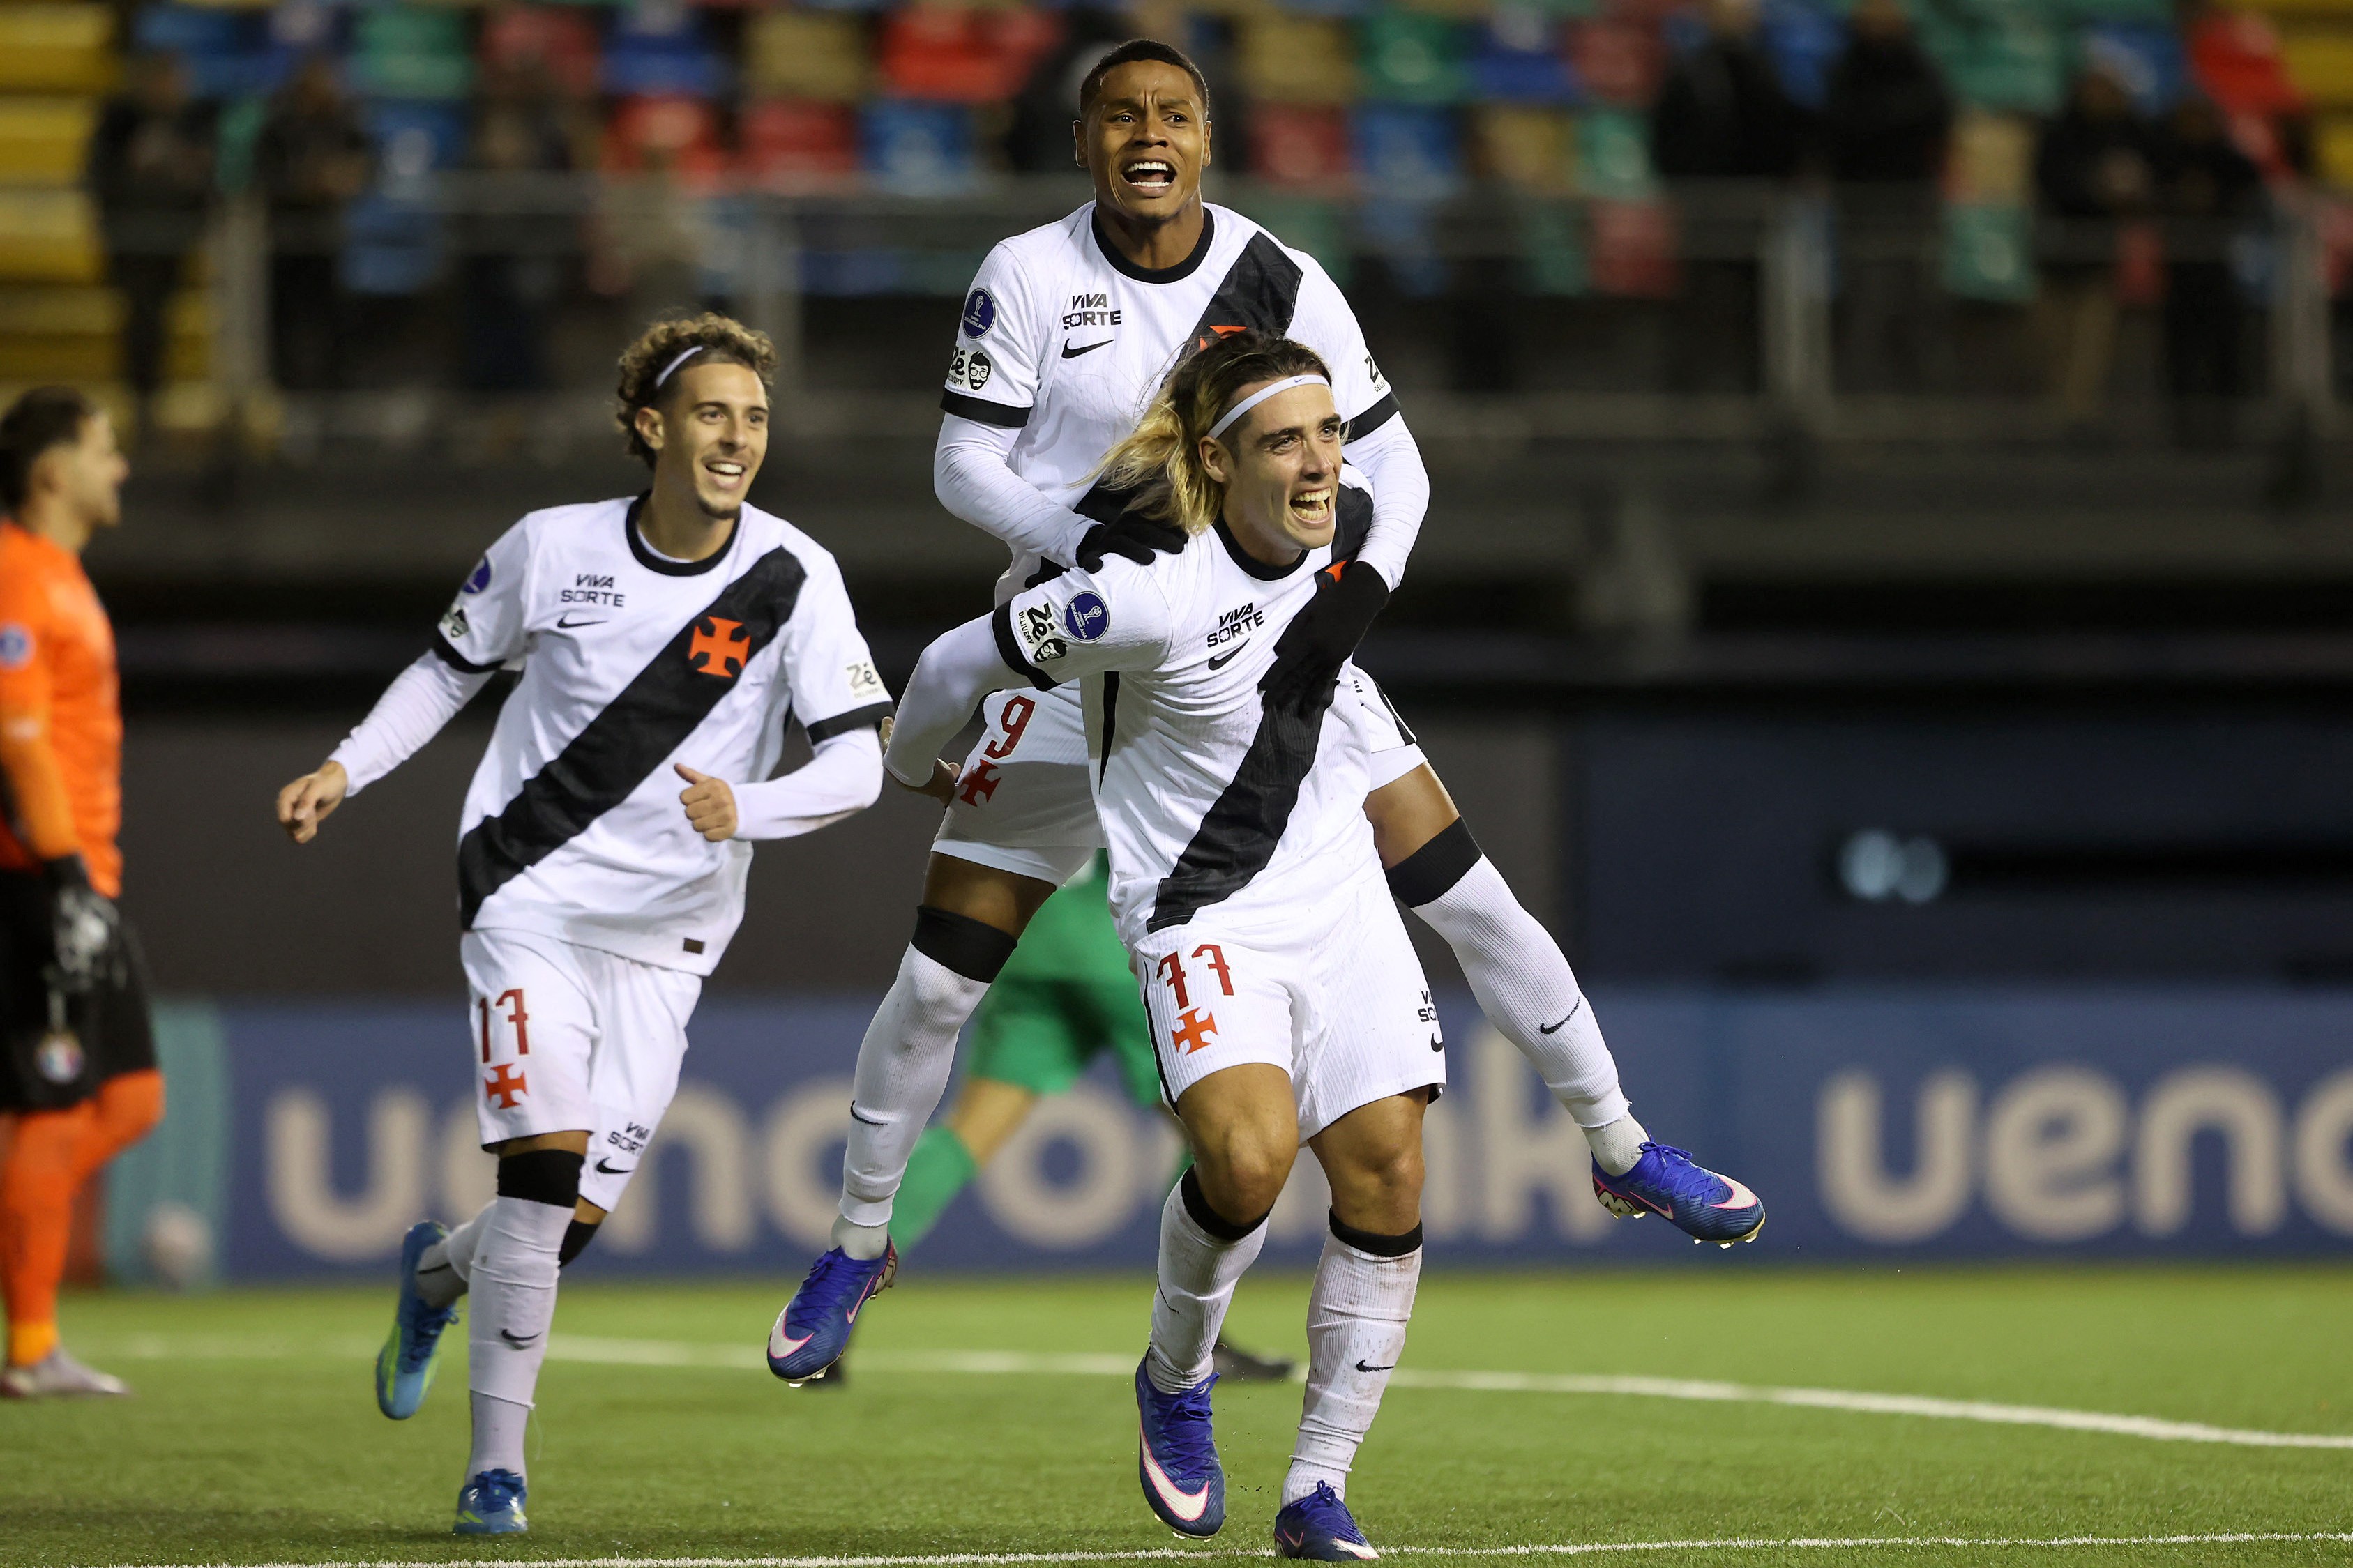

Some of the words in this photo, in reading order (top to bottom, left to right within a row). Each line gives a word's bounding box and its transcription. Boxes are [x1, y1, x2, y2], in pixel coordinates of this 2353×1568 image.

[1072, 294, 1107, 310] VIVA
[1062, 310, 1122, 330] SORTE
[576, 574, 615, 588] VIVA
[561, 590, 625, 607] SORTE
[1018, 611, 1034, 645] DELIVERY
[1027, 602, 1056, 641] Zé
[1207, 610, 1264, 648] SORTE
[1219, 602, 1253, 627] VIVA
[847, 662, 877, 689] Zé
[983, 694, 1036, 760] 9
[1156, 944, 1234, 1010] 77
[478, 988, 530, 1063] 17
